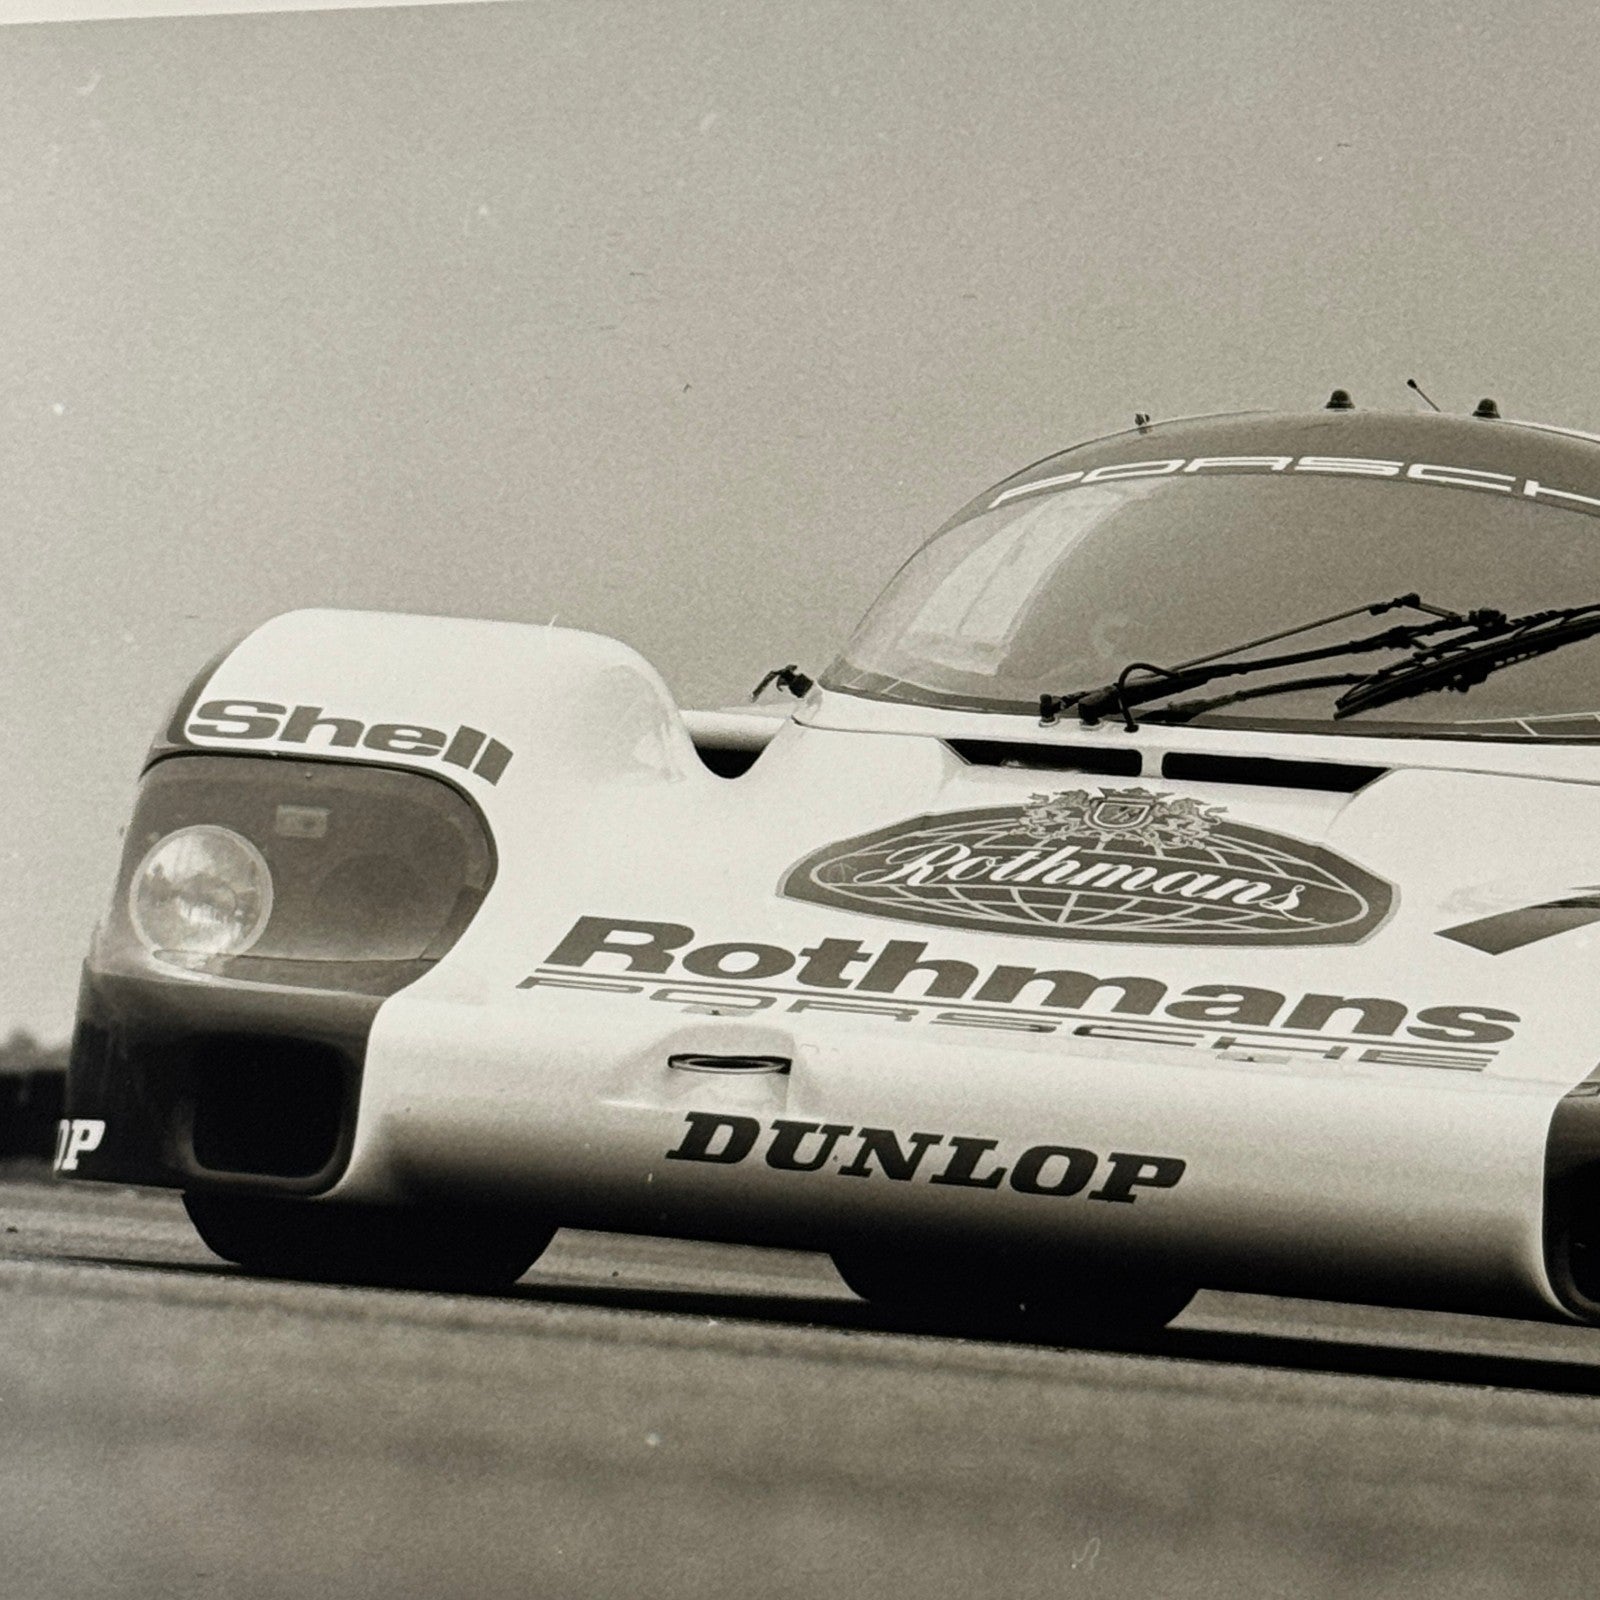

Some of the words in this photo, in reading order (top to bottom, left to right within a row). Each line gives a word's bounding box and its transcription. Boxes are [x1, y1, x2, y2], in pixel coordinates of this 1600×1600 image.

[188, 700, 514, 786] Shell
[853, 841, 1314, 922] Rothmans
[516, 976, 1493, 1072] PORSCHE
[543, 916, 1521, 1043] Rothmans
[665, 1111, 1187, 1203] DUNLOP
